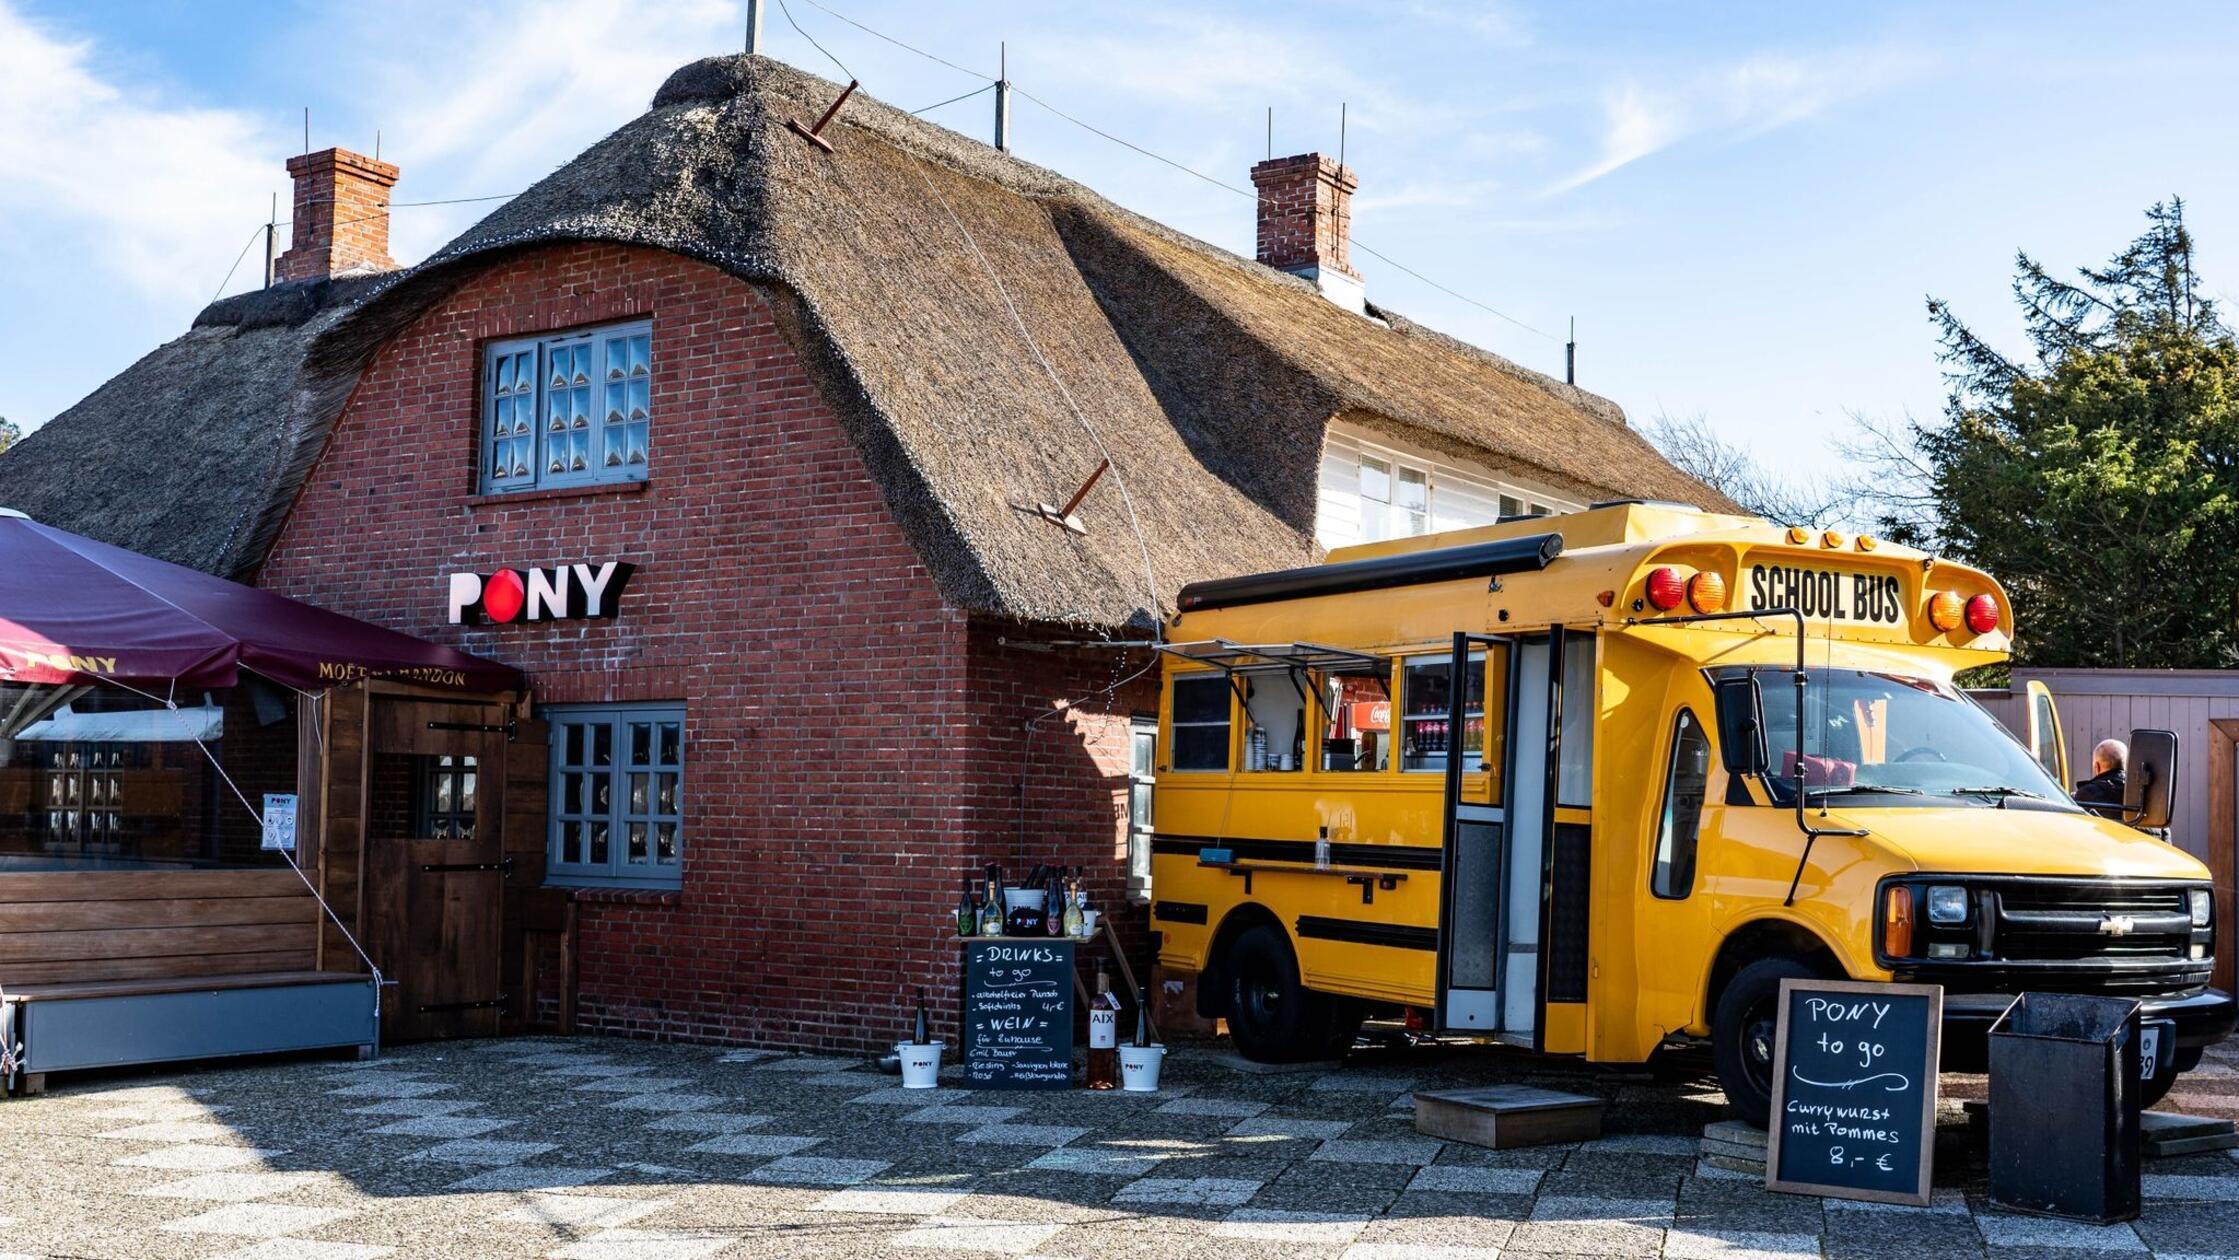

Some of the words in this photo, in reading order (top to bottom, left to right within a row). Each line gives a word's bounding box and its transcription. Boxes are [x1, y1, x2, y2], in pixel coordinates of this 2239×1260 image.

[449, 562, 618, 624] PONY
[1751, 564, 1846, 619] SCHOOL
[1853, 573, 1899, 624] BUS
[26, 651, 117, 673] PONY
[986, 946, 1053, 962] DRINKS
[989, 967, 1004, 977] to
[1012, 968, 1031, 982] go
[990, 1016, 1035, 1031] WEIN
[1092, 1013, 1114, 1024] AIX
[1805, 998, 1891, 1029] PONY
[1817, 1032, 1844, 1054] to
[1858, 1041, 1885, 1068] go
[1791, 1121, 1820, 1136] mit
[1824, 1122, 1899, 1144] Pommes
